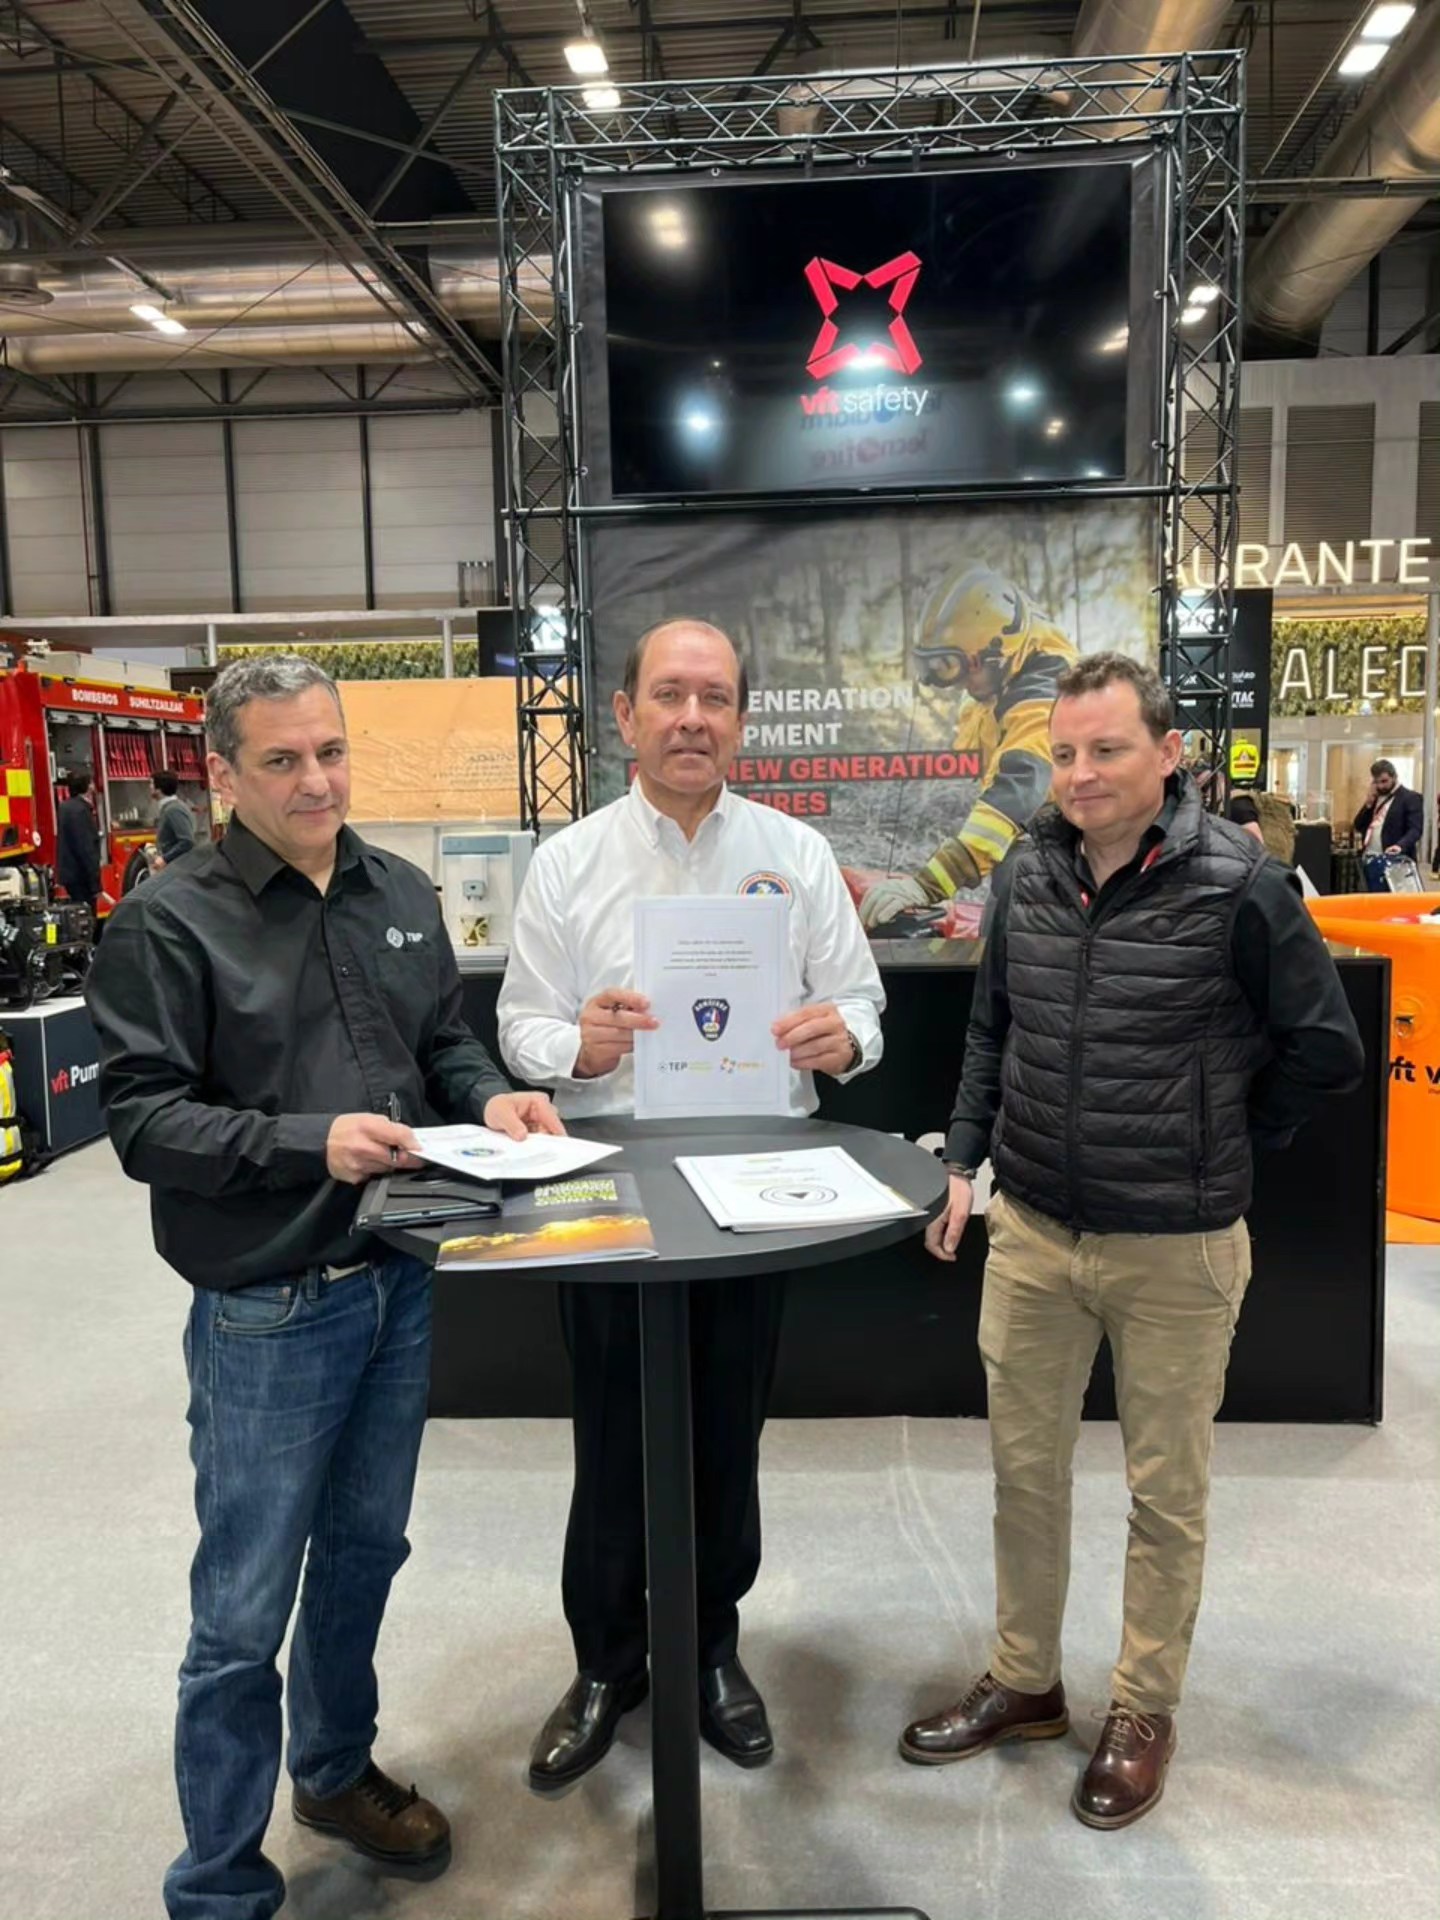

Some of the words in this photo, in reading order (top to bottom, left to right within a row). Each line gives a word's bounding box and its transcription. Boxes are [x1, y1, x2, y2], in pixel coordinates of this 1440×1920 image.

[843, 384, 929, 416] safety
[71, 688, 119, 706] BOMBEROS
[748, 686, 915, 713] ENERATION
[743, 722, 842, 747] PMENT
[789, 752, 980, 781] GENERATION
[668, 1061, 688, 1072] TEP
